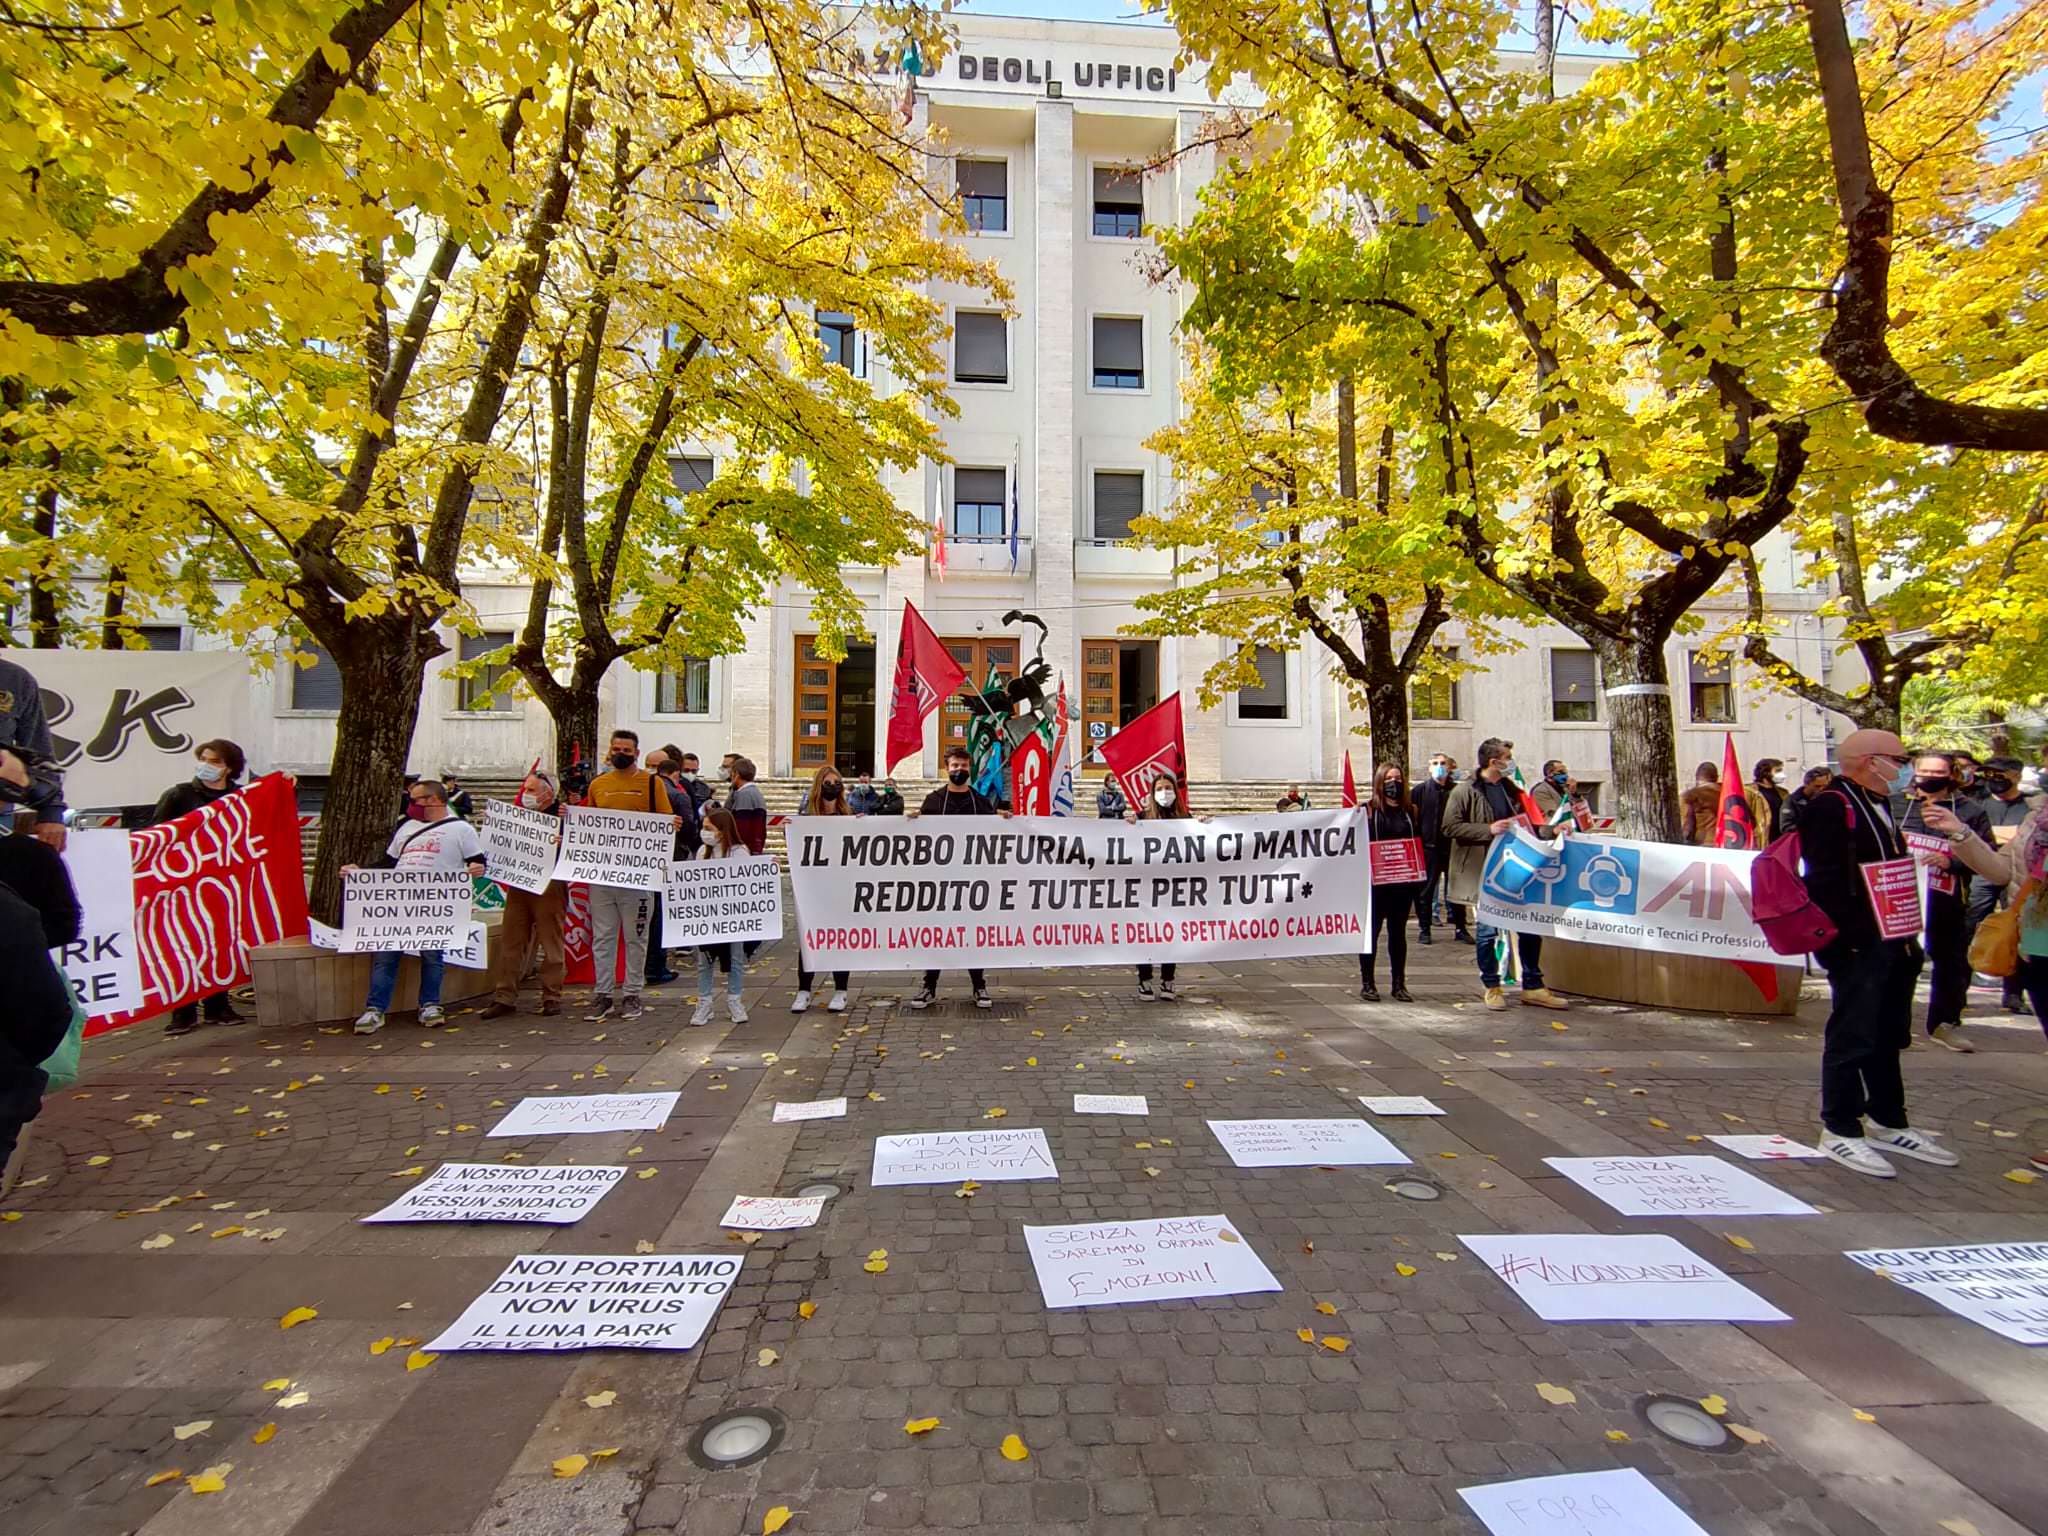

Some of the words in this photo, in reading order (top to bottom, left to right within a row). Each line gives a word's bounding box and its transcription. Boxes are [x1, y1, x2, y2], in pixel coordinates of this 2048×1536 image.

[959, 55, 1052, 83] DEGLI
[1075, 62, 1176, 92] UFFICI
[487, 801, 504, 814] NOI
[506, 805, 558, 829] PORTIAMO
[484, 816, 557, 845] DIVERTIMENTO
[565, 814, 575, 826] IL
[578, 815, 625, 831] NOSTRO
[628, 821, 674, 835] LAVORO
[490, 833, 513, 849] NON
[515, 840, 545, 858] VIRUS
[568, 828, 576, 844] È
[579, 832, 595, 845] UN
[598, 834, 642, 850] DIRITTO
[645, 838, 669, 853] CHE
[800, 835, 829, 867] IL
[840, 834, 955, 867] MORBO
[962, 834, 1096, 870] INFURIA,
[1105, 837, 1133, 865] IL
[1143, 835, 1206, 865] PAN
[1216, 832, 1243, 862] CI
[1252, 826, 1357, 861] MANCA
[492, 854, 517, 869] LUNA
[518, 860, 544, 877] PARK
[565, 850, 612, 866] NESSUN
[614, 854, 667, 871] SINDACO
[347, 872, 376, 884] NOI
[381, 872, 470, 884] PORTIAMO
[485, 865, 503, 878] EVE
[504, 871, 538, 889] VIVERE
[572, 866, 598, 881] PUÒ
[600, 870, 650, 886] NEGARE
[675, 867, 726, 882] NOSTRO
[730, 863, 779, 879] LAVORO
[346, 888, 471, 901] DIVERTIMENTO
[668, 886, 676, 901] È
[679, 888, 696, 901] UN
[700, 884, 747, 899] DIRITTO
[750, 882, 775, 895] CHE
[853, 880, 990, 913] REDDITO
[999, 879, 1018, 911] E
[1028, 878, 1142, 910] TUTELE
[1151, 877, 1209, 908] PER
[362, 906, 398, 918] NON
[404, 905, 454, 918] VIRUS
[669, 904, 718, 920] NESSUN
[721, 900, 776, 916] SINDACO
[356, 926, 369, 937] IL
[373, 926, 412, 937] LUNA
[416, 925, 455, 936] PARK
[683, 920, 709, 937] PUÒ
[712, 919, 763, 934] NEGARE
[887, 926, 970, 950] LAVORAT.
[976, 925, 1026, 948] DELLA
[1032, 923, 1105, 946] CULTURA
[1111, 923, 1120, 945] E
[1125, 921, 1175, 945] DELLO
[1181, 917, 1280, 942] SPETTACOLO
[1286, 913, 1362, 937] CALABRIA
[1530, 911, 1583, 929] Nazionale
[1585, 918, 1644, 937] Lavoratori
[1647, 928, 1655, 938] e
[1656, 926, 1699, 943] Tecnici
[355, 940, 394, 951] DEVE
[399, 940, 450, 950] VIVERE
[531, 1101, 580, 1111] NON
[890, 1137, 925, 1148] VOI
[935, 1135, 960, 1146] LA
[967, 1131, 1042, 1144] CHIAMATE
[433, 1167, 449, 1180] IL
[455, 1168, 539, 1180] NOSTRO
[539, 1169, 623, 1182] LAVORO
[887, 1162, 927, 1174] PER
[932, 1161, 961, 1171] NOI
[1592, 1160, 1688, 1172] SENZA
[423, 1180, 443, 1192] È
[442, 1183, 476, 1194] UN
[475, 1184, 558, 1194] DIRITTO
[558, 1184, 603, 1195] CHE
[1592, 1174, 1726, 1186] CULTURA
[403, 1195, 492, 1208] NESSUN
[493, 1197, 588, 1209] SINDACO
[1640, 1196, 1751, 1210] MUORE
[731, 1214, 815, 1227] DANZA
[1044, 1227, 1137, 1245] SENZA
[1155, 1219, 1218, 1238] ARTE
[1047, 1242, 1147, 1261] SAREMMO
[1157, 1238, 1216, 1250] ORFANI
[507, 1260, 567, 1277] NOI
[572, 1260, 736, 1277] PORTIAMO
[1121, 1258, 1146, 1268] DI
[1851, 1252, 1914, 1268] NOI
[1888, 1267, 2048, 1285] DIVERTIME
[488, 1280, 729, 1296] DIVERTIMENTO
[1945, 1285, 2028, 1300] NON
[501, 1298, 576, 1314] NON
[587, 1299, 686, 1315] VIRUS
[1984, 1310, 2025, 1323] IL
[471, 1323, 497, 1337] IL
[505, 1323, 586, 1338] LUNA
[593, 1323, 679, 1337] PARK
[1505, 1494, 1622, 1526] FORA
